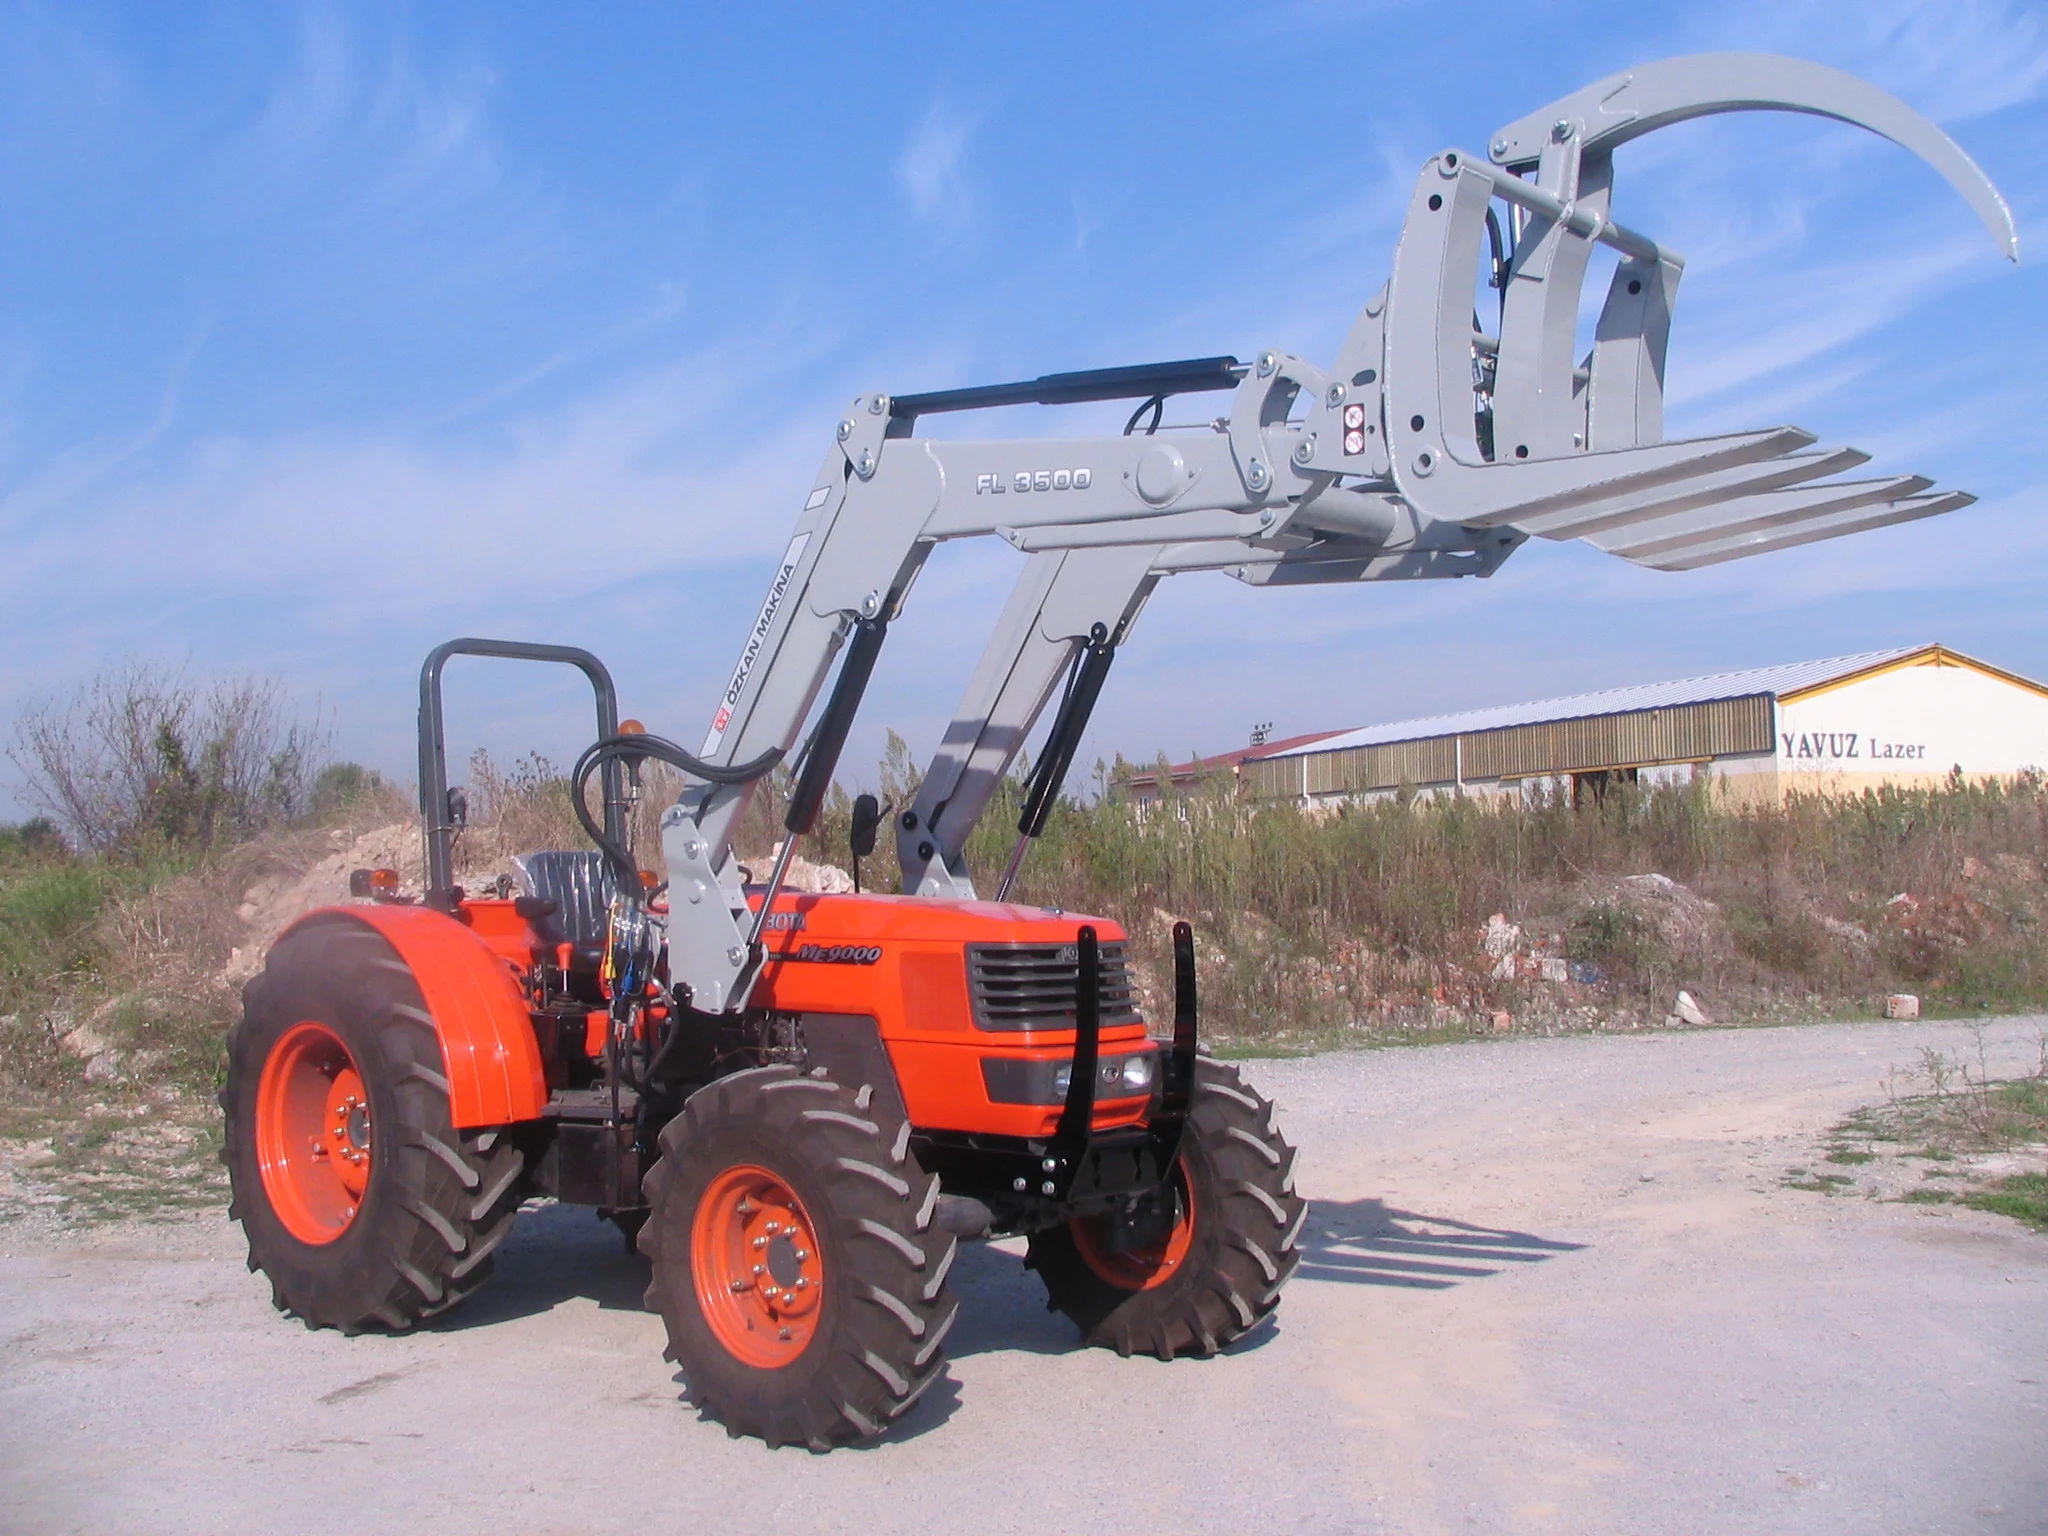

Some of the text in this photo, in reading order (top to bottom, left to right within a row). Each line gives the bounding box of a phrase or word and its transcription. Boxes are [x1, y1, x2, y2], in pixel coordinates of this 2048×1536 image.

[976, 467, 1092, 495] FL 3500
[727, 639, 760, 705] ÖZKAN
[1781, 733, 1926, 759] YAVUZ Lazer
[753, 911, 806, 931] BOTA
[797, 943, 883, 963] ME9000
